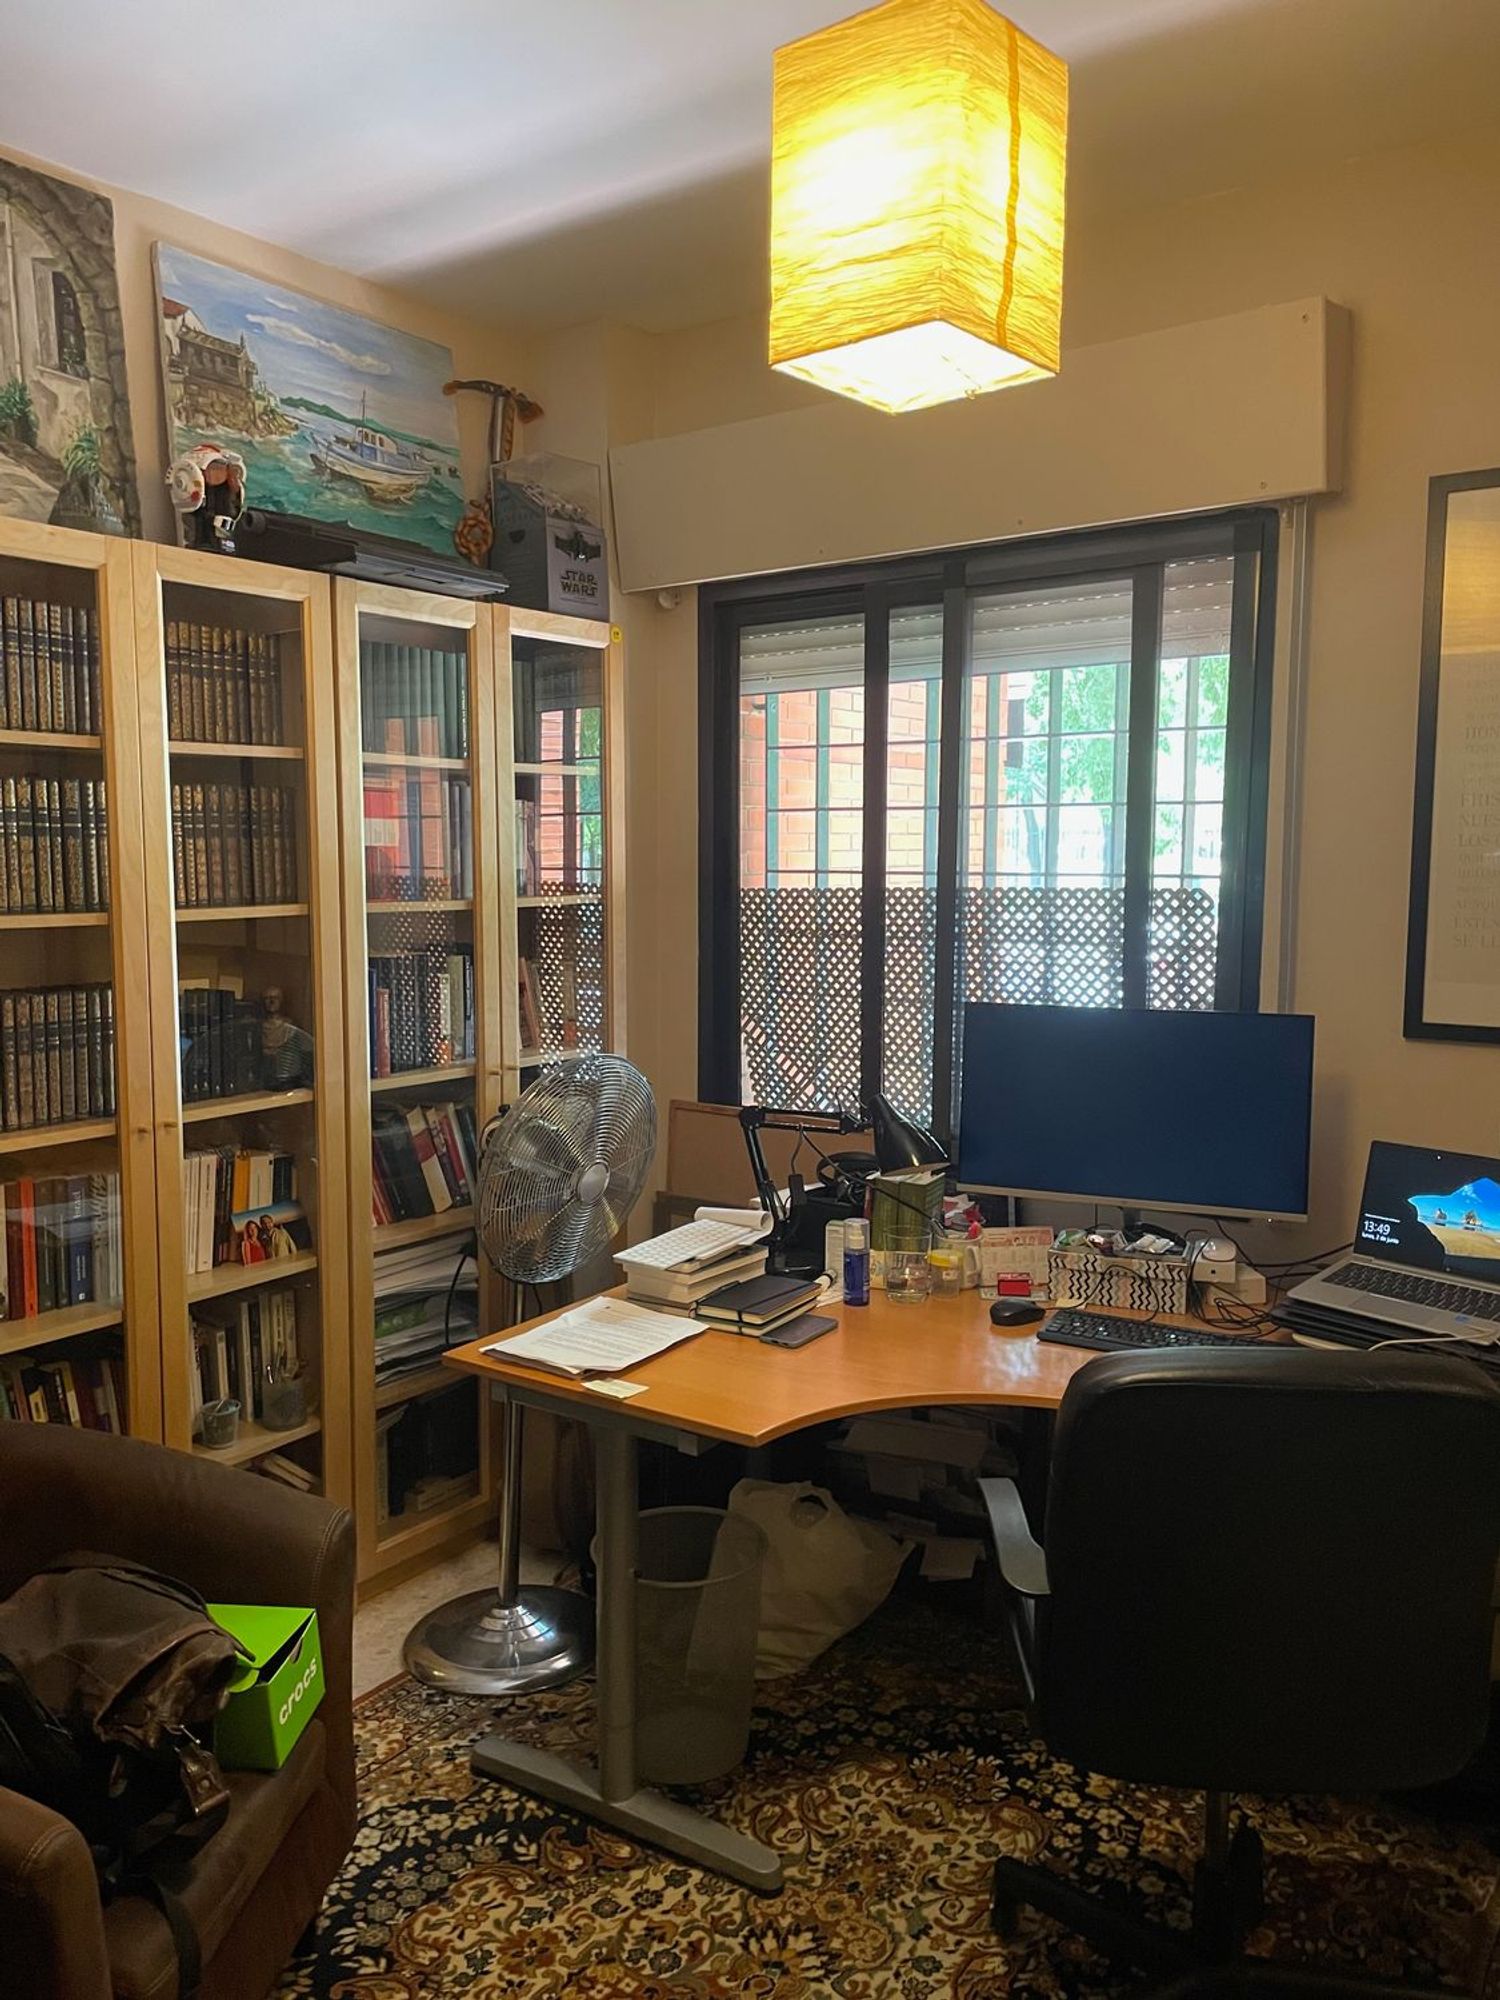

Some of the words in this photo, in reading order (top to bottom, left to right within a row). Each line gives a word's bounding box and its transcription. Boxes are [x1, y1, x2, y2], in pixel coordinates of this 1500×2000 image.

[560, 570, 597, 585] STAR
[561, 581, 598, 596] WARS
[1364, 1221, 1391, 1236] 13:49
[279, 1657, 317, 1726] crocs
